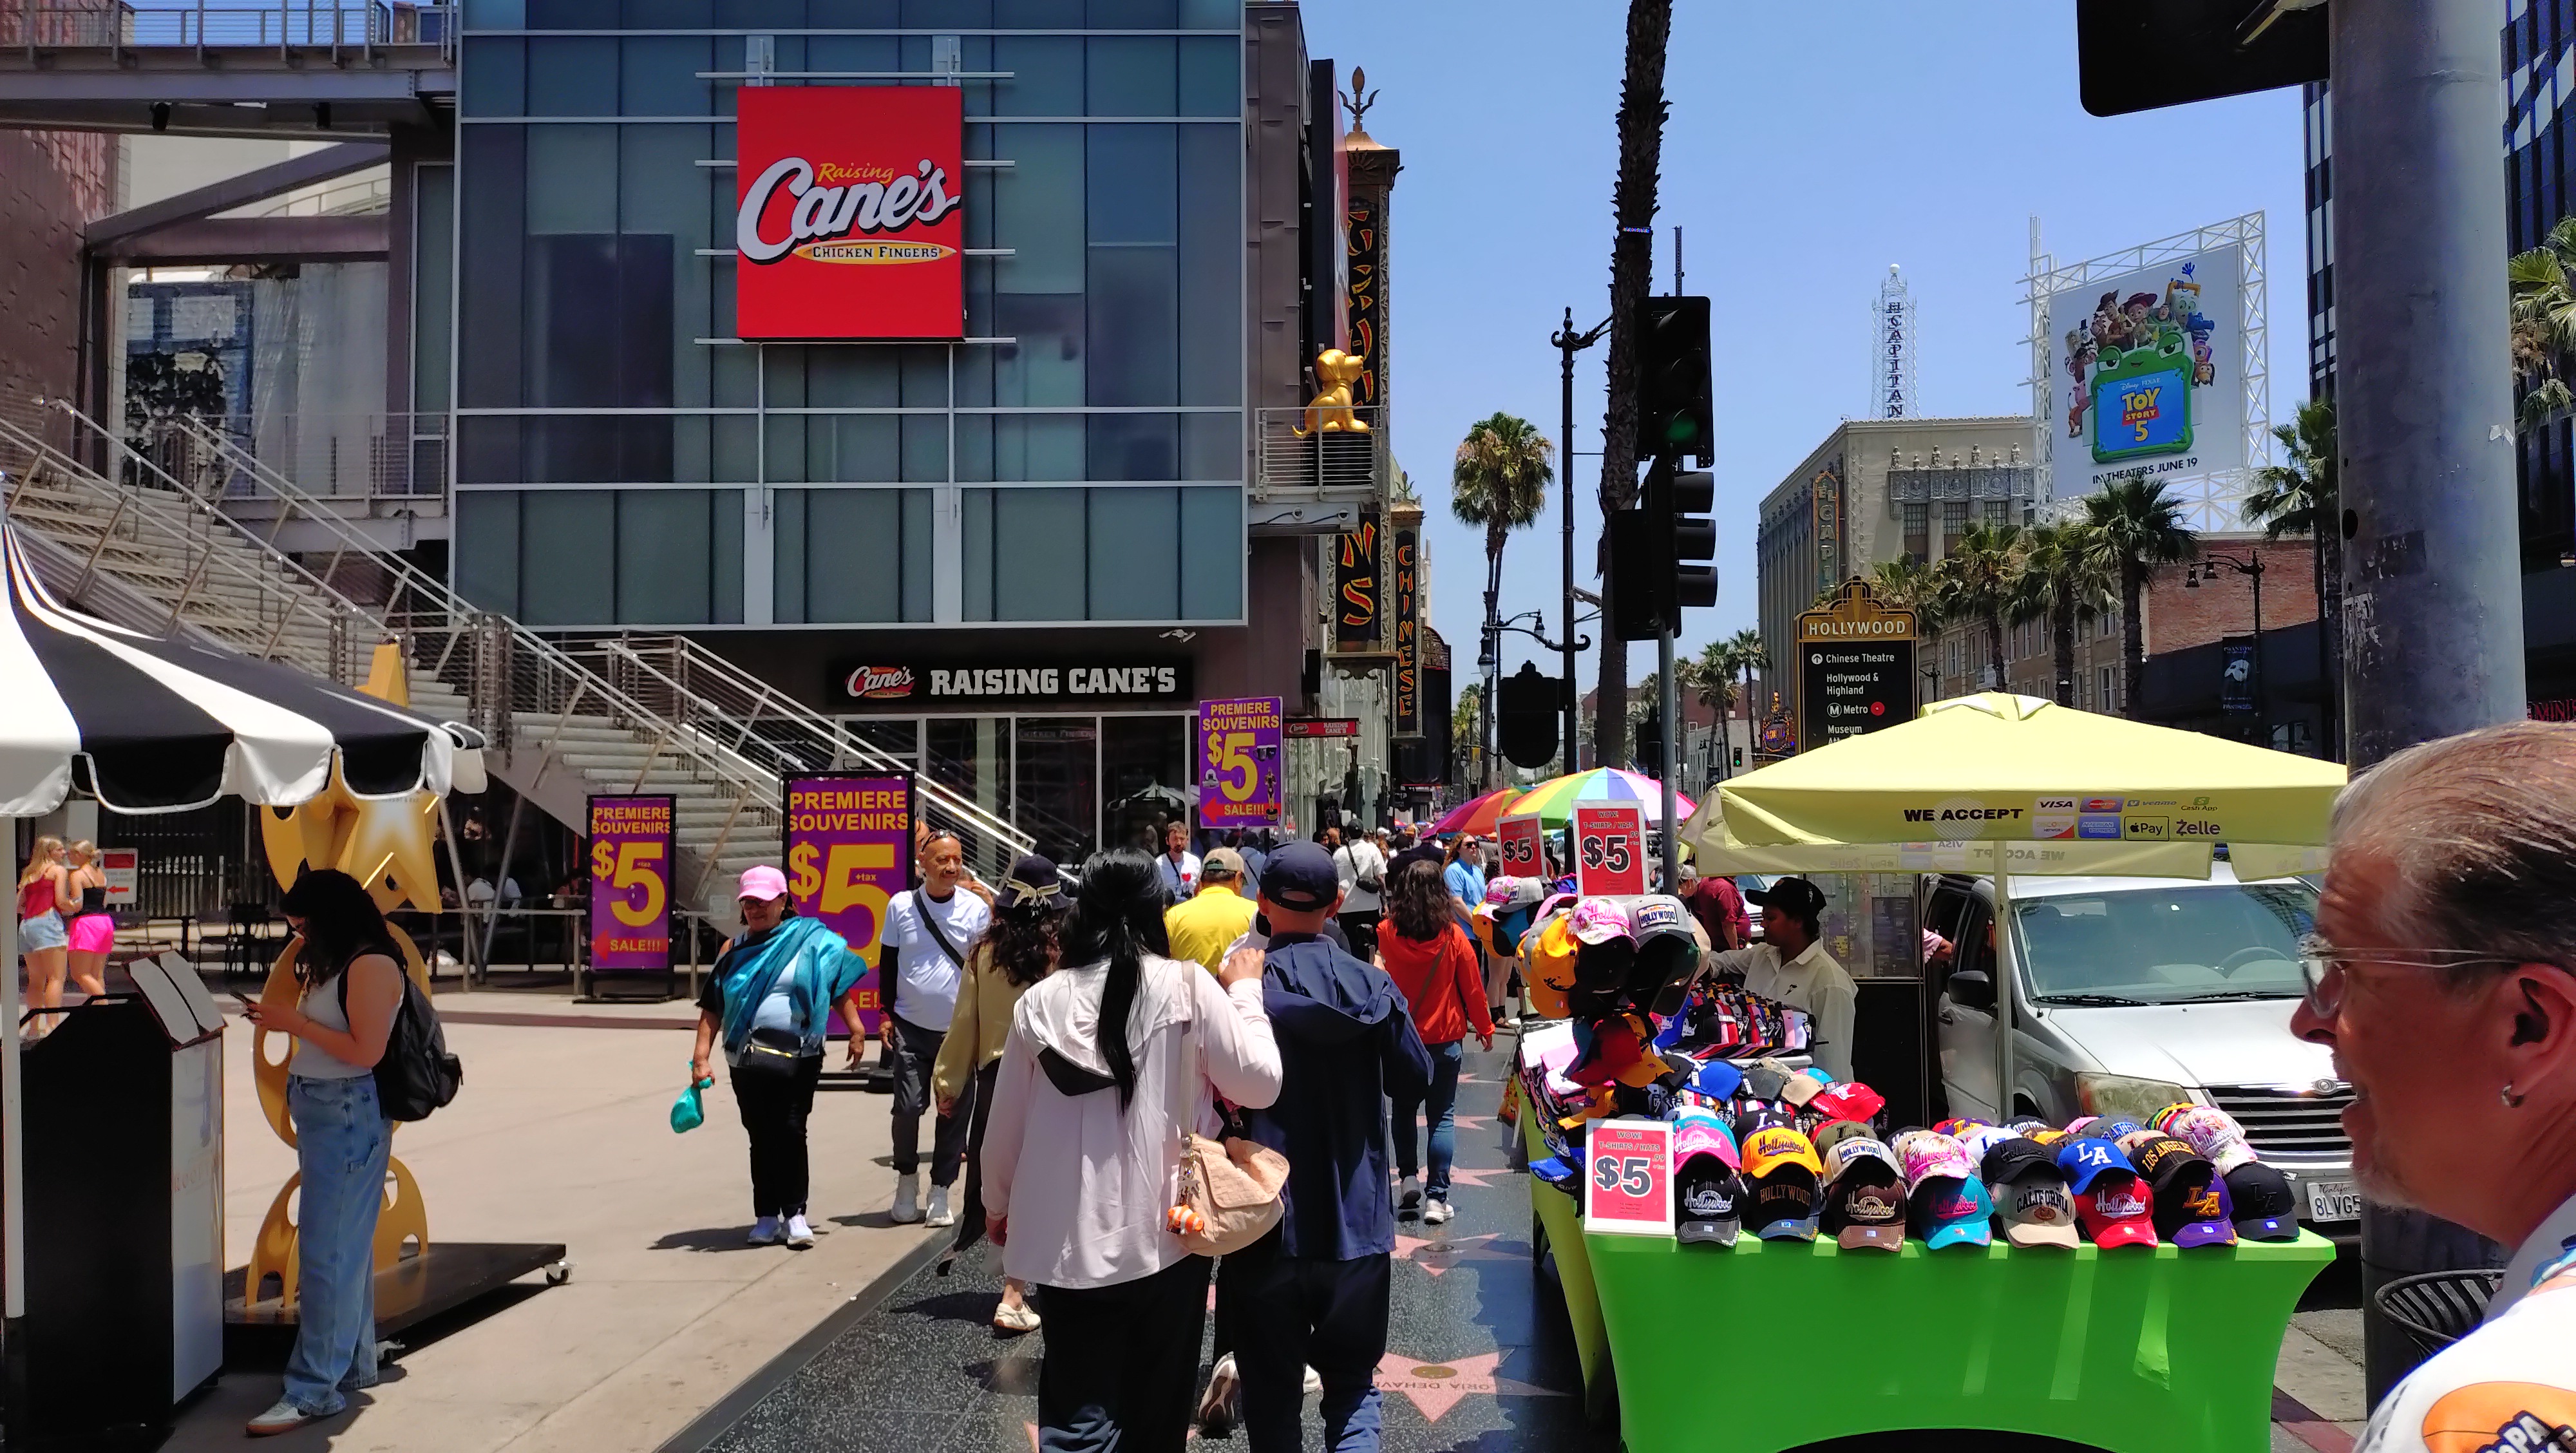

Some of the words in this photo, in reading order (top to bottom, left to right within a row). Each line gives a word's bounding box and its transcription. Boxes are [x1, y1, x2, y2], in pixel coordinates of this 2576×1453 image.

[817, 162, 895, 184] Raising
[737, 157, 961, 263] Cane's
[813, 245, 873, 258] CHICKEN
[878, 245, 940, 258] FINGERS
[2121, 386, 2161, 412] TOY
[2125, 409, 2157, 421] STORY
[2134, 420, 2149, 442] 5
[2092, 473, 2104, 484] IN
[2107, 464, 2155, 482] THEATERS
[2157, 460, 2184, 473] JUNE
[2187, 457, 2198, 468] 19
[1818, 486, 1836, 502] EL
[1397, 544, 1414, 716] CHINESE
[1809, 620, 1906, 636] HOLLYWOOD
[1826, 654, 1859, 663] Chinese
[1862, 652, 1895, 663] Theatre
[847, 665, 915, 697] Cane's
[930, 669, 1059, 696] RAISING
[1068, 667, 1175, 694] CANE'S
[1826, 672, 1870, 684] Hollywood
[1873, 672, 1879, 681] &
[1826, 685, 1864, 697] Highland
[1210, 701, 1271, 716] PREMIERE
[1843, 705, 1868, 714] Metro
[1202, 715, 1280, 732] SOUVENIRS
[1827, 725, 1862, 734] Museum
[1207, 731, 1258, 803] $5
[790, 790, 906, 810] PREMIERE
[1224, 804, 1264, 816] SALE!!!
[592, 806, 670, 821] PREMIERE
[790, 813, 908, 832] SOUVENIRS
[1903, 808, 1936, 822] WE
[1940, 808, 2024, 821] ACCEPT
[2140, 822, 2163, 835] Pay
[2175, 819, 2221, 837] Zelle
[1502, 837, 1534, 864] $5
[1582, 834, 1631, 873] $5
[592, 839, 667, 927] $5
[789, 840, 895, 969] $5
[1640, 910, 1676, 924] HOLLYWOOD
[610, 939, 661, 952] SALE!!!
[1616, 1131, 1642, 1139] WOW!
[1758, 1134, 1806, 1155] Hollywood
[1598, 1141, 1633, 1150] T-SHIRTS
[1841, 1146, 1879, 1159] HOLLYWOOD
[2078, 1142, 2112, 1167] LA
[2142, 1148, 2159, 1173] LOS
[2156, 1139, 2196, 1157] ANGELES
[1594, 1155, 1653, 1197] $5
[1684, 1184, 1734, 1213] Hollywood
[1760, 1184, 1811, 1207] HOLLYWOOD
[1845, 1190, 1897, 1218] Hollywood
[2016, 1188, 2069, 1216] CALIFORNIA
[2095, 1189, 2146, 1213] Hollywood
[2183, 1185, 2221, 1217] LA
[2040, 1208, 2052, 1218] CA
